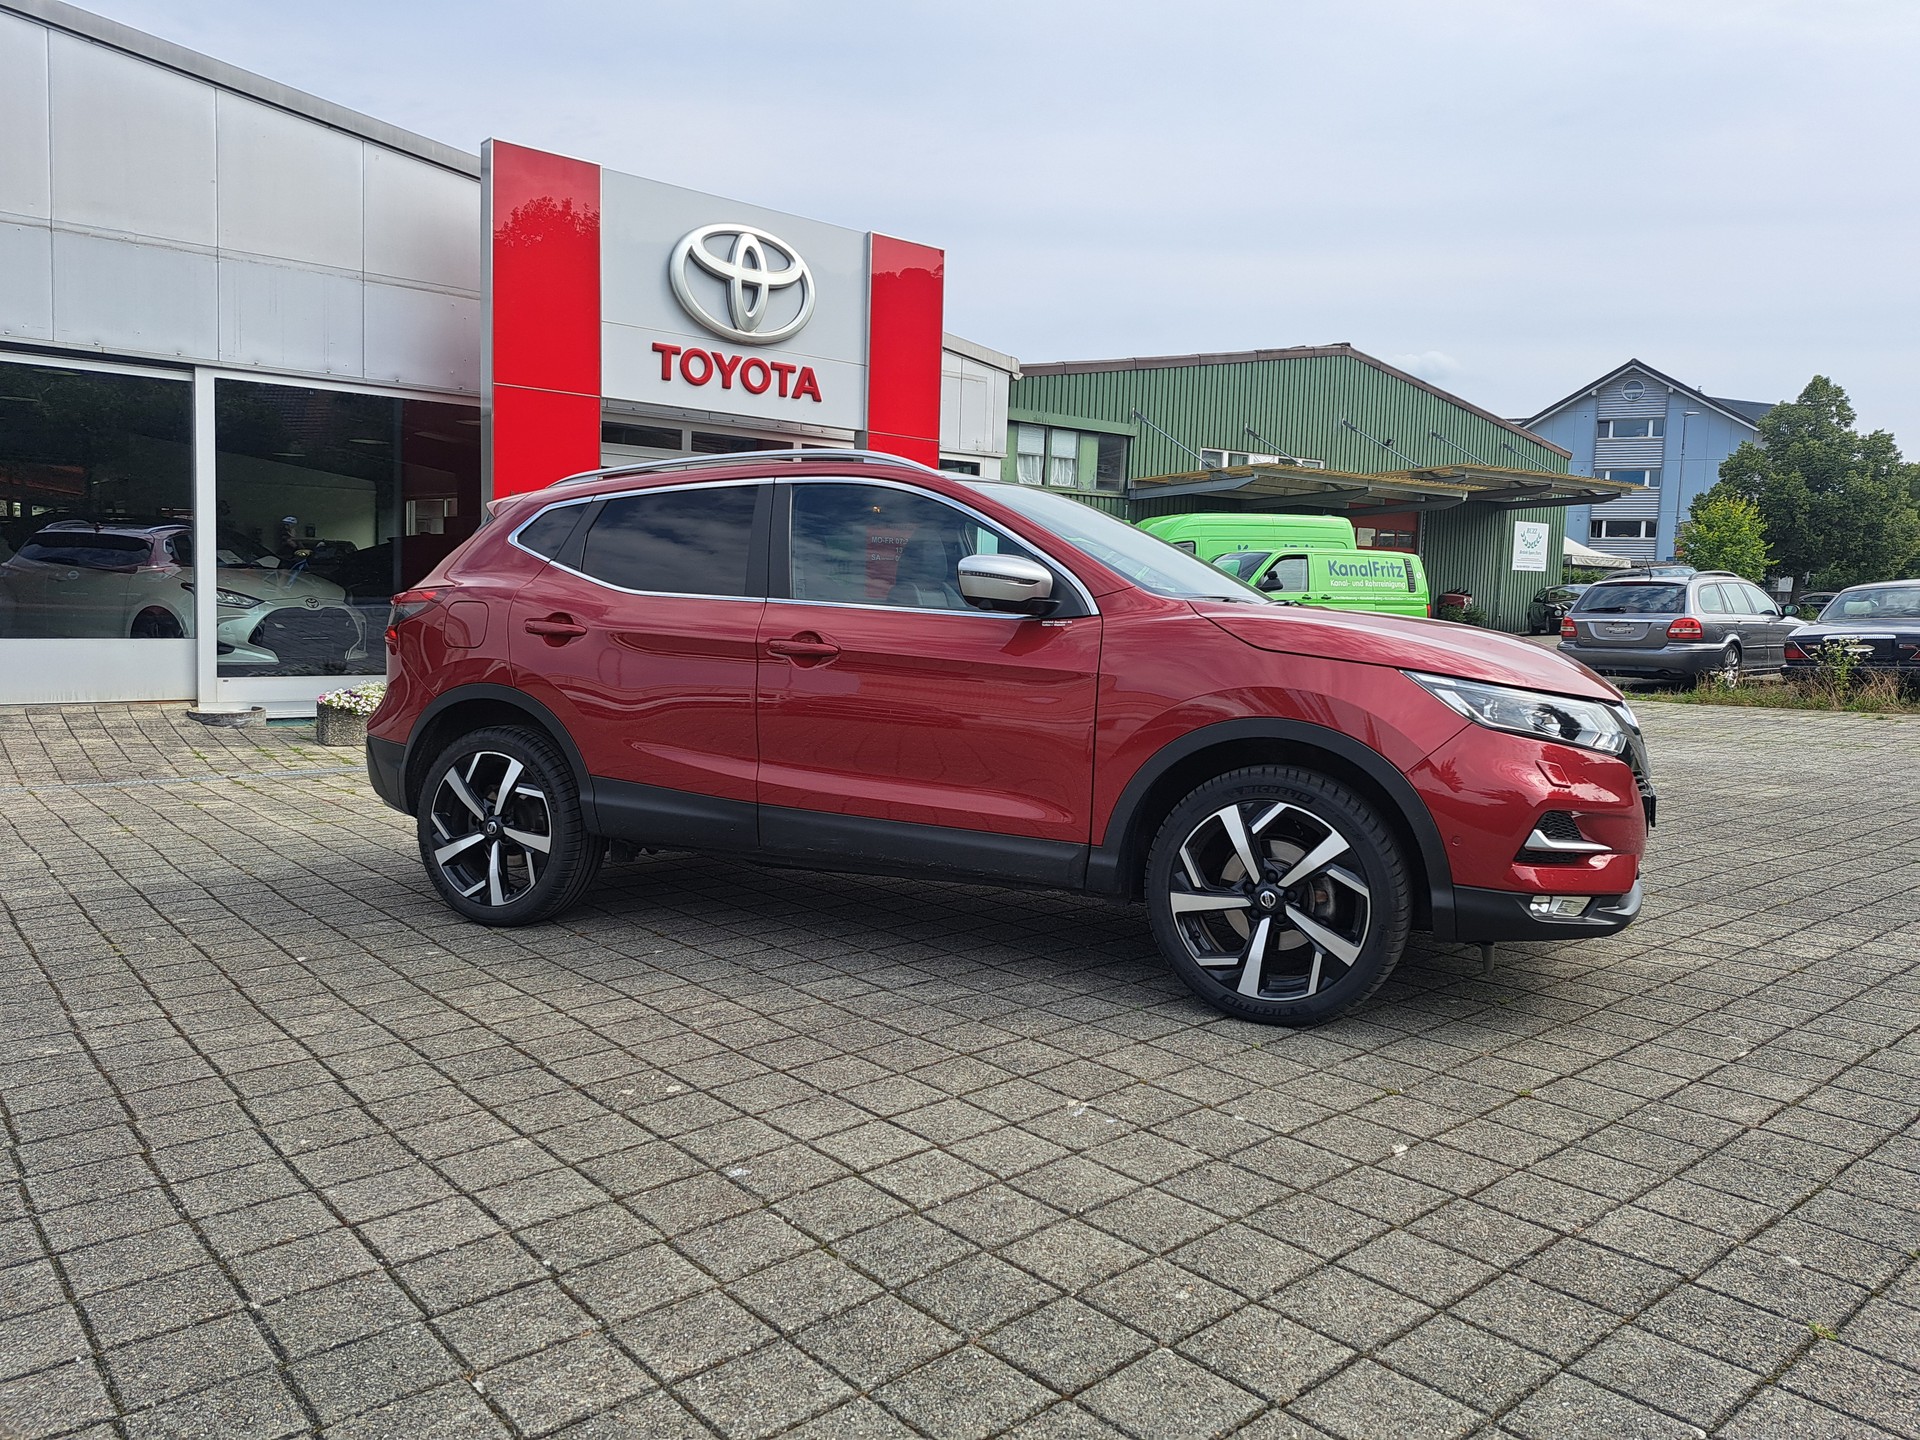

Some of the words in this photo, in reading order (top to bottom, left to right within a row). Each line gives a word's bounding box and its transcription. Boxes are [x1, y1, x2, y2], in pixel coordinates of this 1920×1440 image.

[652, 342, 822, 402] TOYOTA
[871, 553, 881, 561] SA
[1327, 559, 1405, 578] KanalFritz
[1330, 579, 1351, 587] Kanal-
[1352, 579, 1364, 587] und
[1365, 579, 1406, 589] Rohrreinigung
[1242, 785, 1315, 804] MICHELIN
